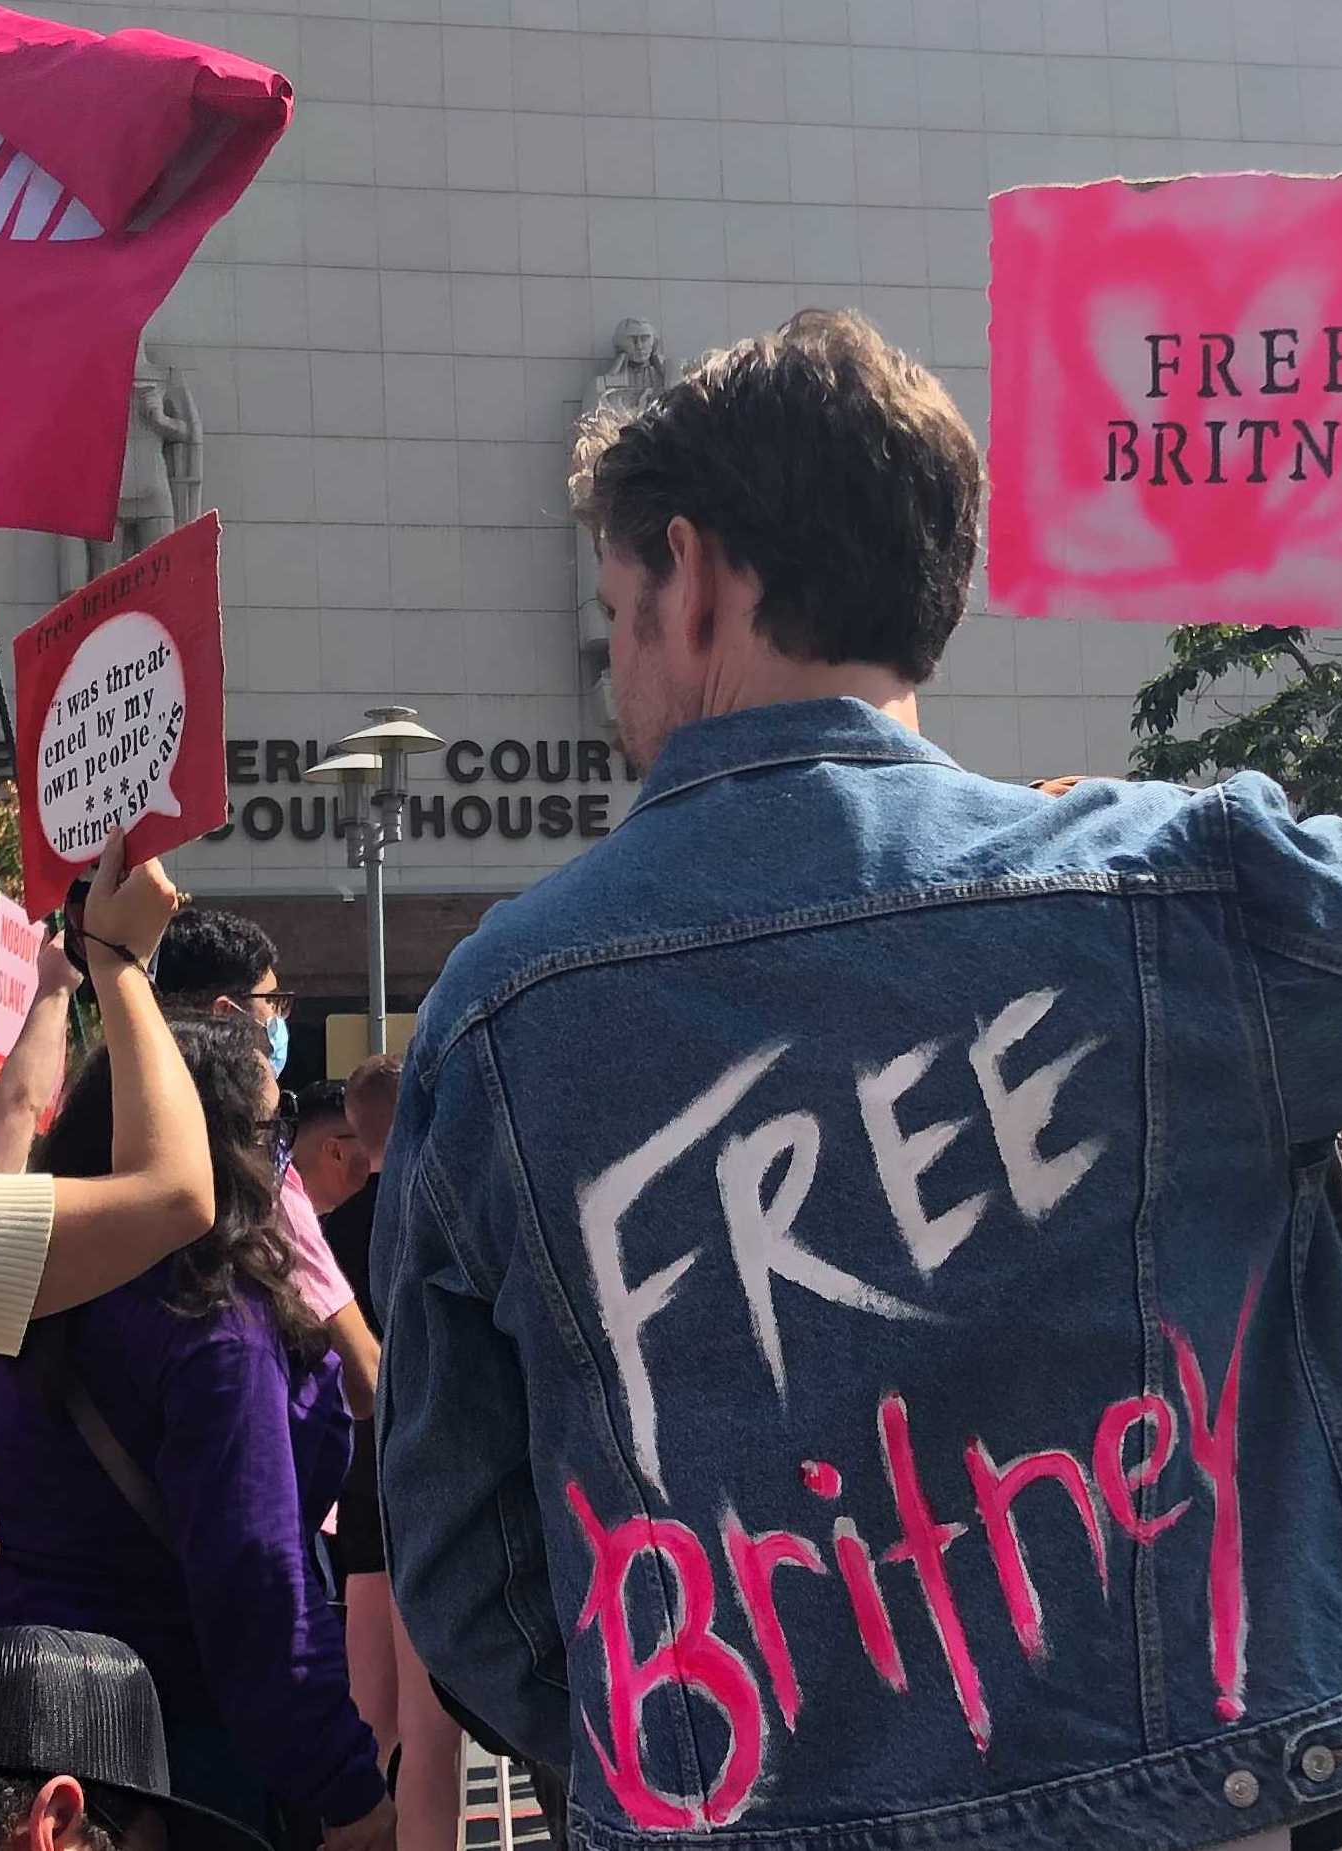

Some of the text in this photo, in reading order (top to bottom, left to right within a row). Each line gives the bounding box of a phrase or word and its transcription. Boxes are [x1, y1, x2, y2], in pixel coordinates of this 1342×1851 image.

[35, 610, 75, 656] free
[67, 678, 100, 719] was
[44, 721, 87, 769] ened
[96, 706, 117, 739] by
[123, 686, 155, 720] my
[126, 699, 184, 818] spears
[444, 739, 641, 784] COUR
[43, 765, 79, 807] own
[205, 794, 611, 842] OUHOUSE
[577, 986, 1112, 1503] FREE
[565, 1266, 1259, 1832] Britney
